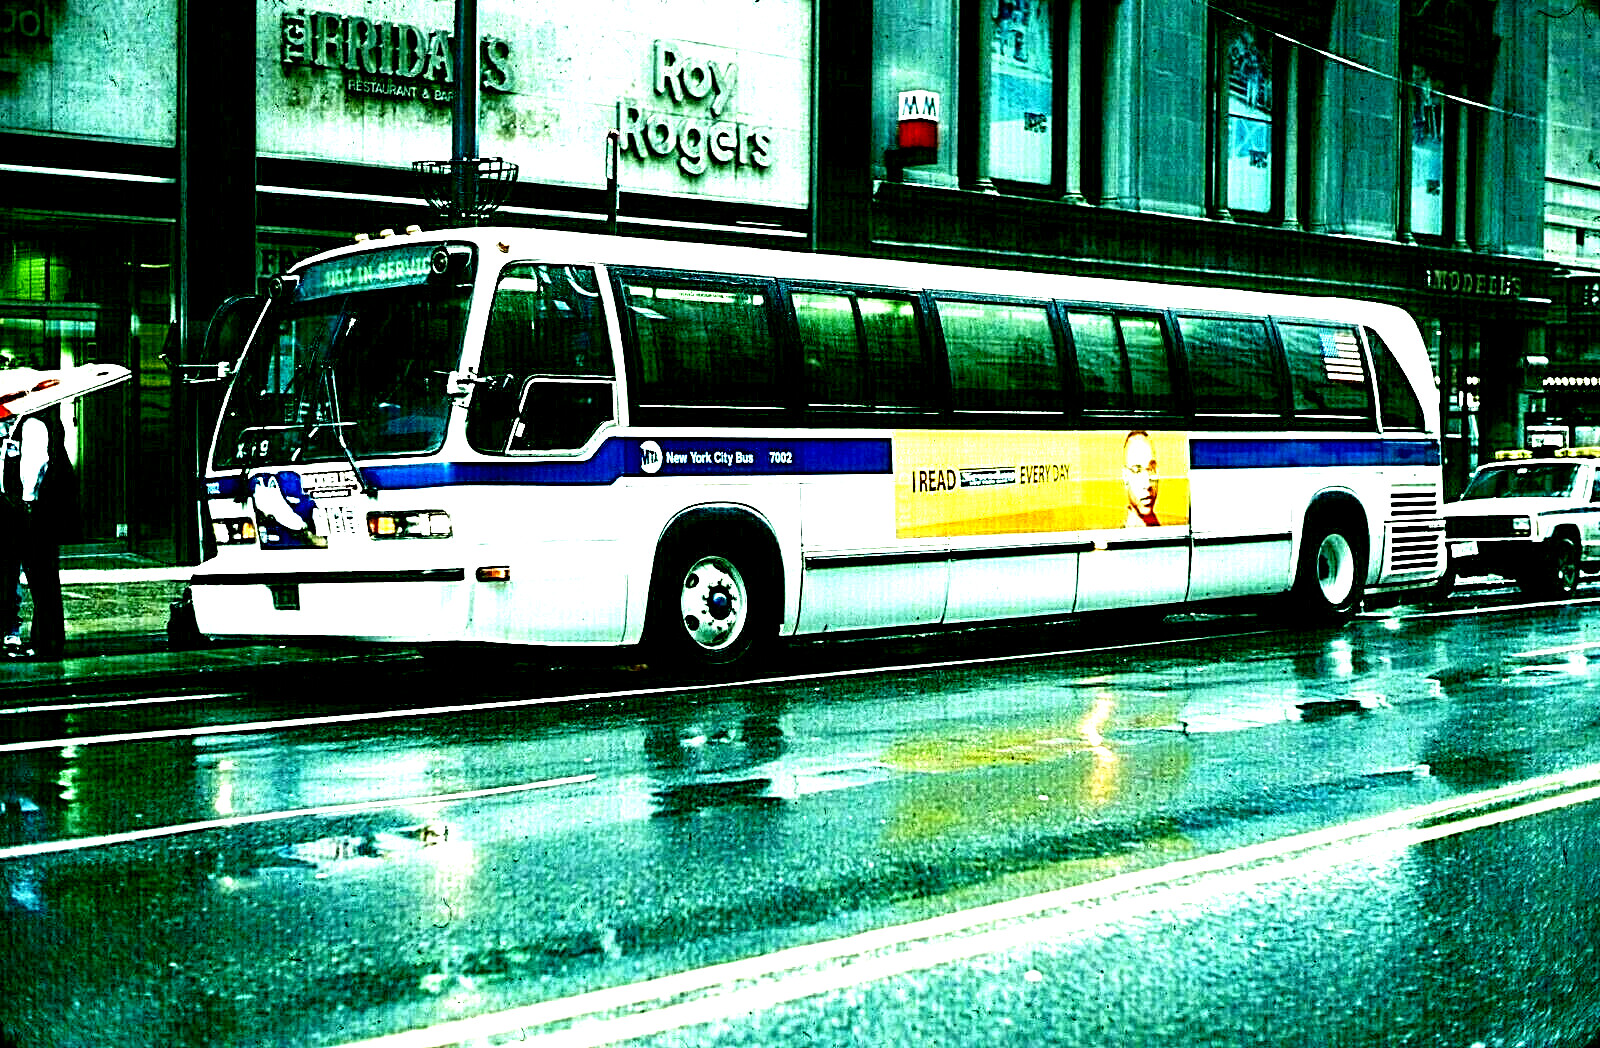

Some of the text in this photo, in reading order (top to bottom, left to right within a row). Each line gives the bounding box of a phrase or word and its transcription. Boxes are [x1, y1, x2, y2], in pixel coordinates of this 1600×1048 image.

[313, 11, 514, 91] FRIDAS
[348, 79, 418, 97] RESTAURANT
[422, 88, 431, 99] &
[653, 39, 739, 116] Roy
[616, 99, 772, 176] Rogers
[326, 256, 431, 288] NOT IN SERVIC
[641, 448, 793, 467] MTA New York City Bus 7002
[919, 469, 957, 492] READ
[1020, 464, 1051, 485] EVERY
[1052, 464, 1070, 483] DAY
